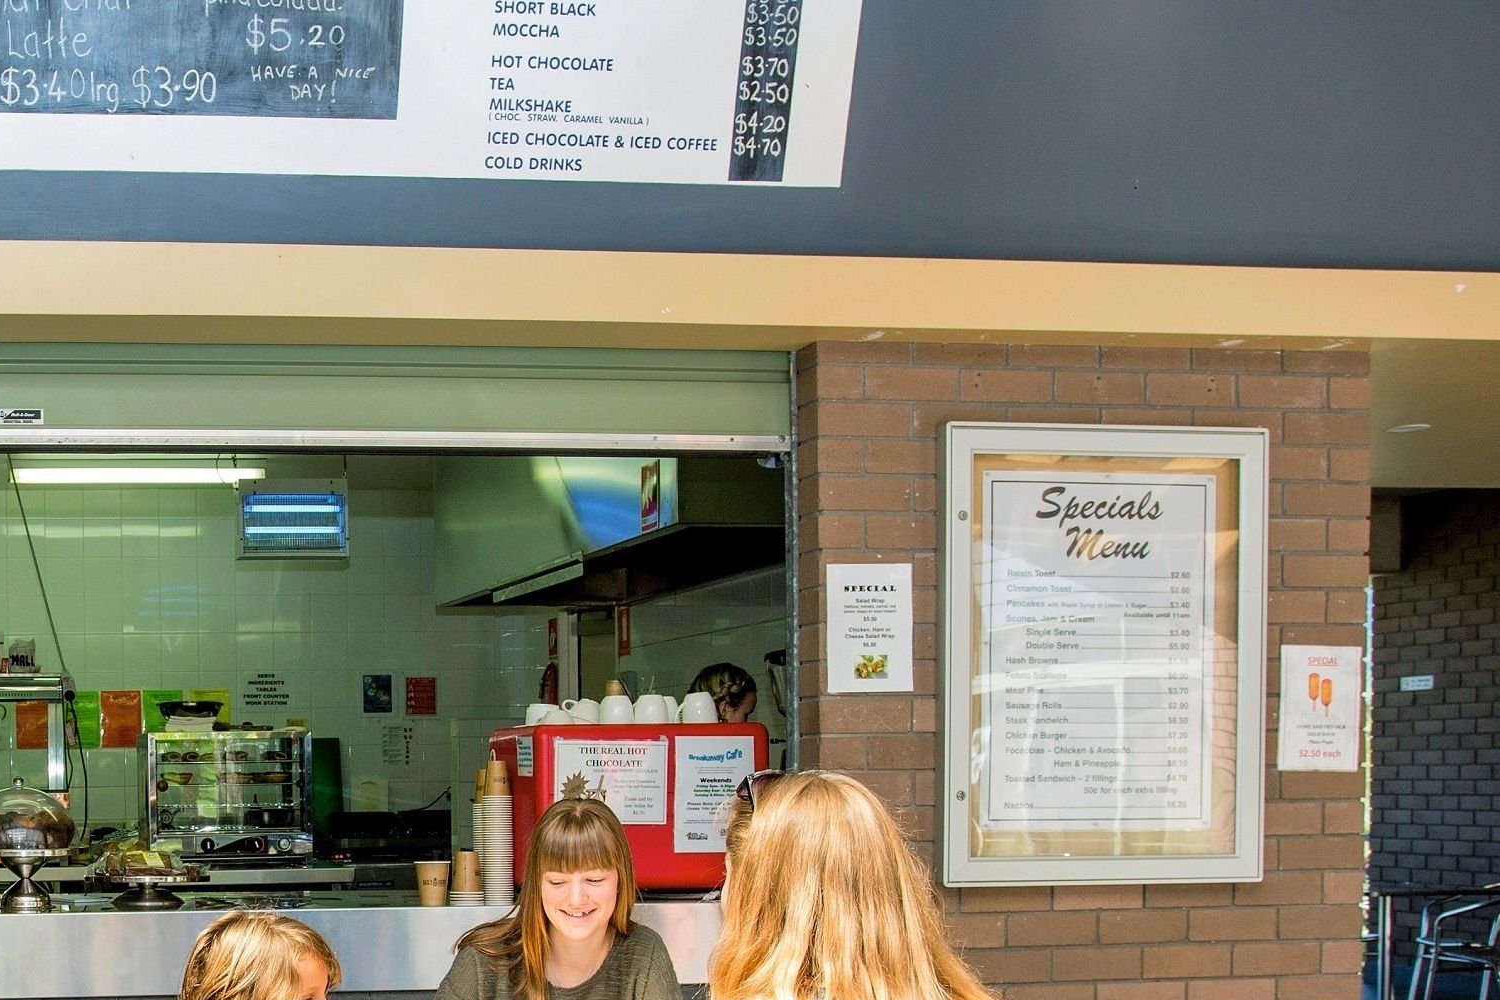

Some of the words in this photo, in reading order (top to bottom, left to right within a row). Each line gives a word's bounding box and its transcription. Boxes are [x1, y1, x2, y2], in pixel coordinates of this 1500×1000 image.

[495, 1, 544, 15] SHORT
[550, 3, 596, 17] BLACK
[747, 5, 799, 25] $3.50
[8, 19, 92, 59] Latte
[246, 13, 345, 55] $5.20
[492, 23, 560, 38] MOCCHA
[744, 27, 797, 47] $3.50
[308, 68, 318, 79] A
[336, 66, 377, 82] NICE
[491, 55, 522, 69] HOT
[528, 56, 614, 71] CHOCOLATE
[741, 56, 788, 78] $3.70
[0, 66, 83, 107] $3.40
[132, 66, 218, 108] $3.90
[290, 81, 337, 104] DAY!
[489, 77, 515, 91] TEA
[739, 81, 789, 103] $2.50
[489, 98, 572, 113] MILKSHAKE
[735, 113, 785, 135] $4.20
[563, 115, 603, 124] CARAMEL
[609, 116, 643, 126] VANILLA
[488, 132, 519, 146] ICED
[525, 133, 609, 149] CHOCOLATE
[615, 136, 625, 148] &
[630, 136, 661, 150] ICED
[667, 137, 717, 151] COFFEE
[733, 137, 783, 157] $4.70
[485, 156, 523, 170] COLD
[529, 157, 582, 172] DRINKS
[1035, 486, 1163, 528] Specials
[1065, 526, 1151, 560] Menu
[1007, 585, 1048, 593] Cinnamon
[1050, 585, 1072, 593] Toast
[1007, 600, 1044, 608] Pancakes
[1026, 629, 1051, 637] Single
[10, 655, 36, 667] MALL
[1042, 702, 1062, 710] Rolls
[1040, 732, 1067, 740] Burger
[627, 747, 647, 755] HOT
[689, 754, 725, 762] Breakaway
[1323, 749, 1341, 757] each
